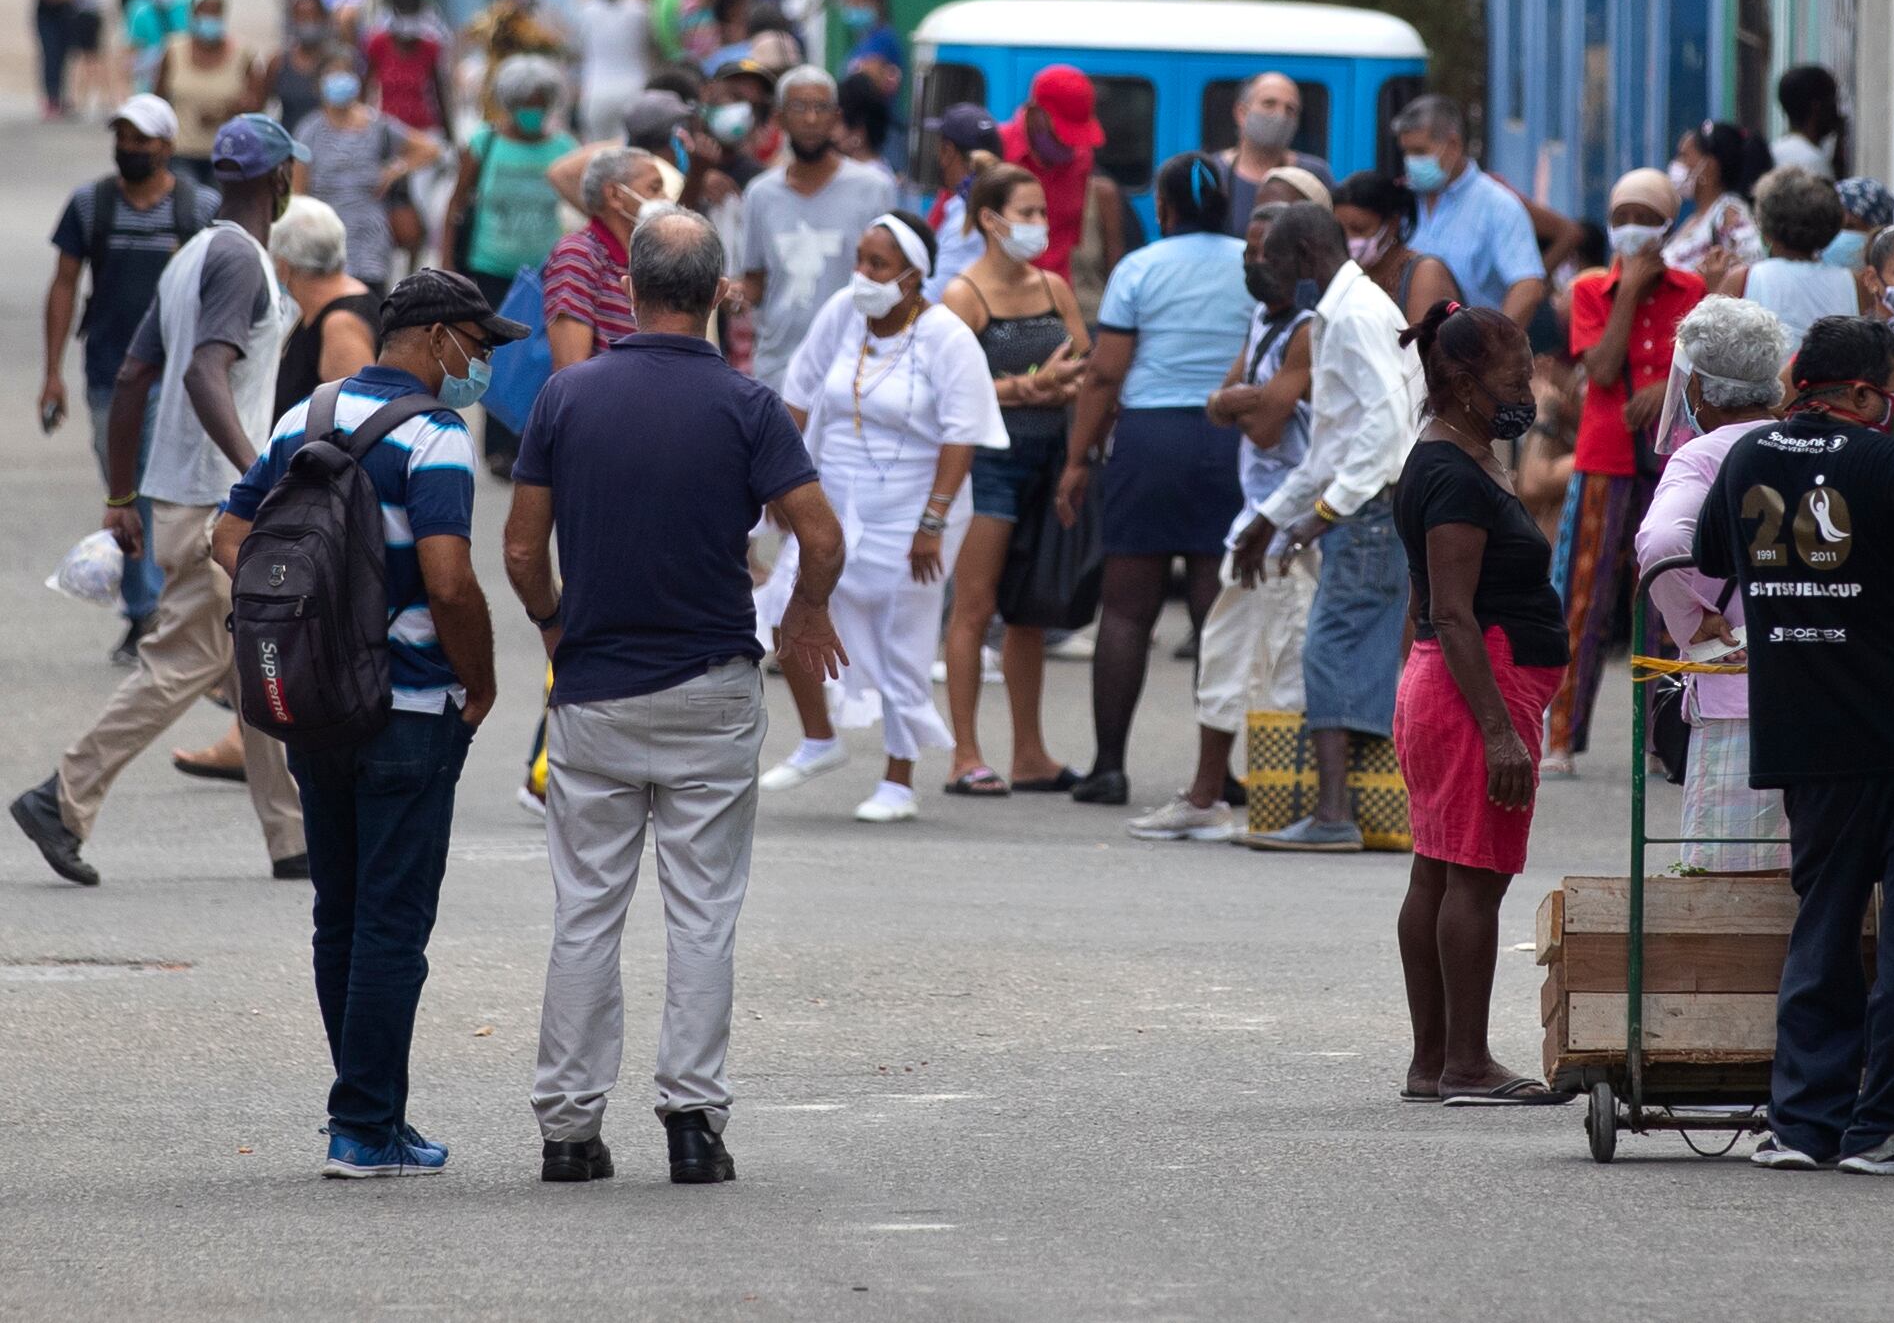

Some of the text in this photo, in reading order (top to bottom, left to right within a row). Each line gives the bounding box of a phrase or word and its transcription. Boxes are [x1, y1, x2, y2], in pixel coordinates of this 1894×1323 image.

[1756, 549, 1777, 560] 1991
[1810, 551, 1837, 562] 2011
[261, 641, 288, 722] Supreme
